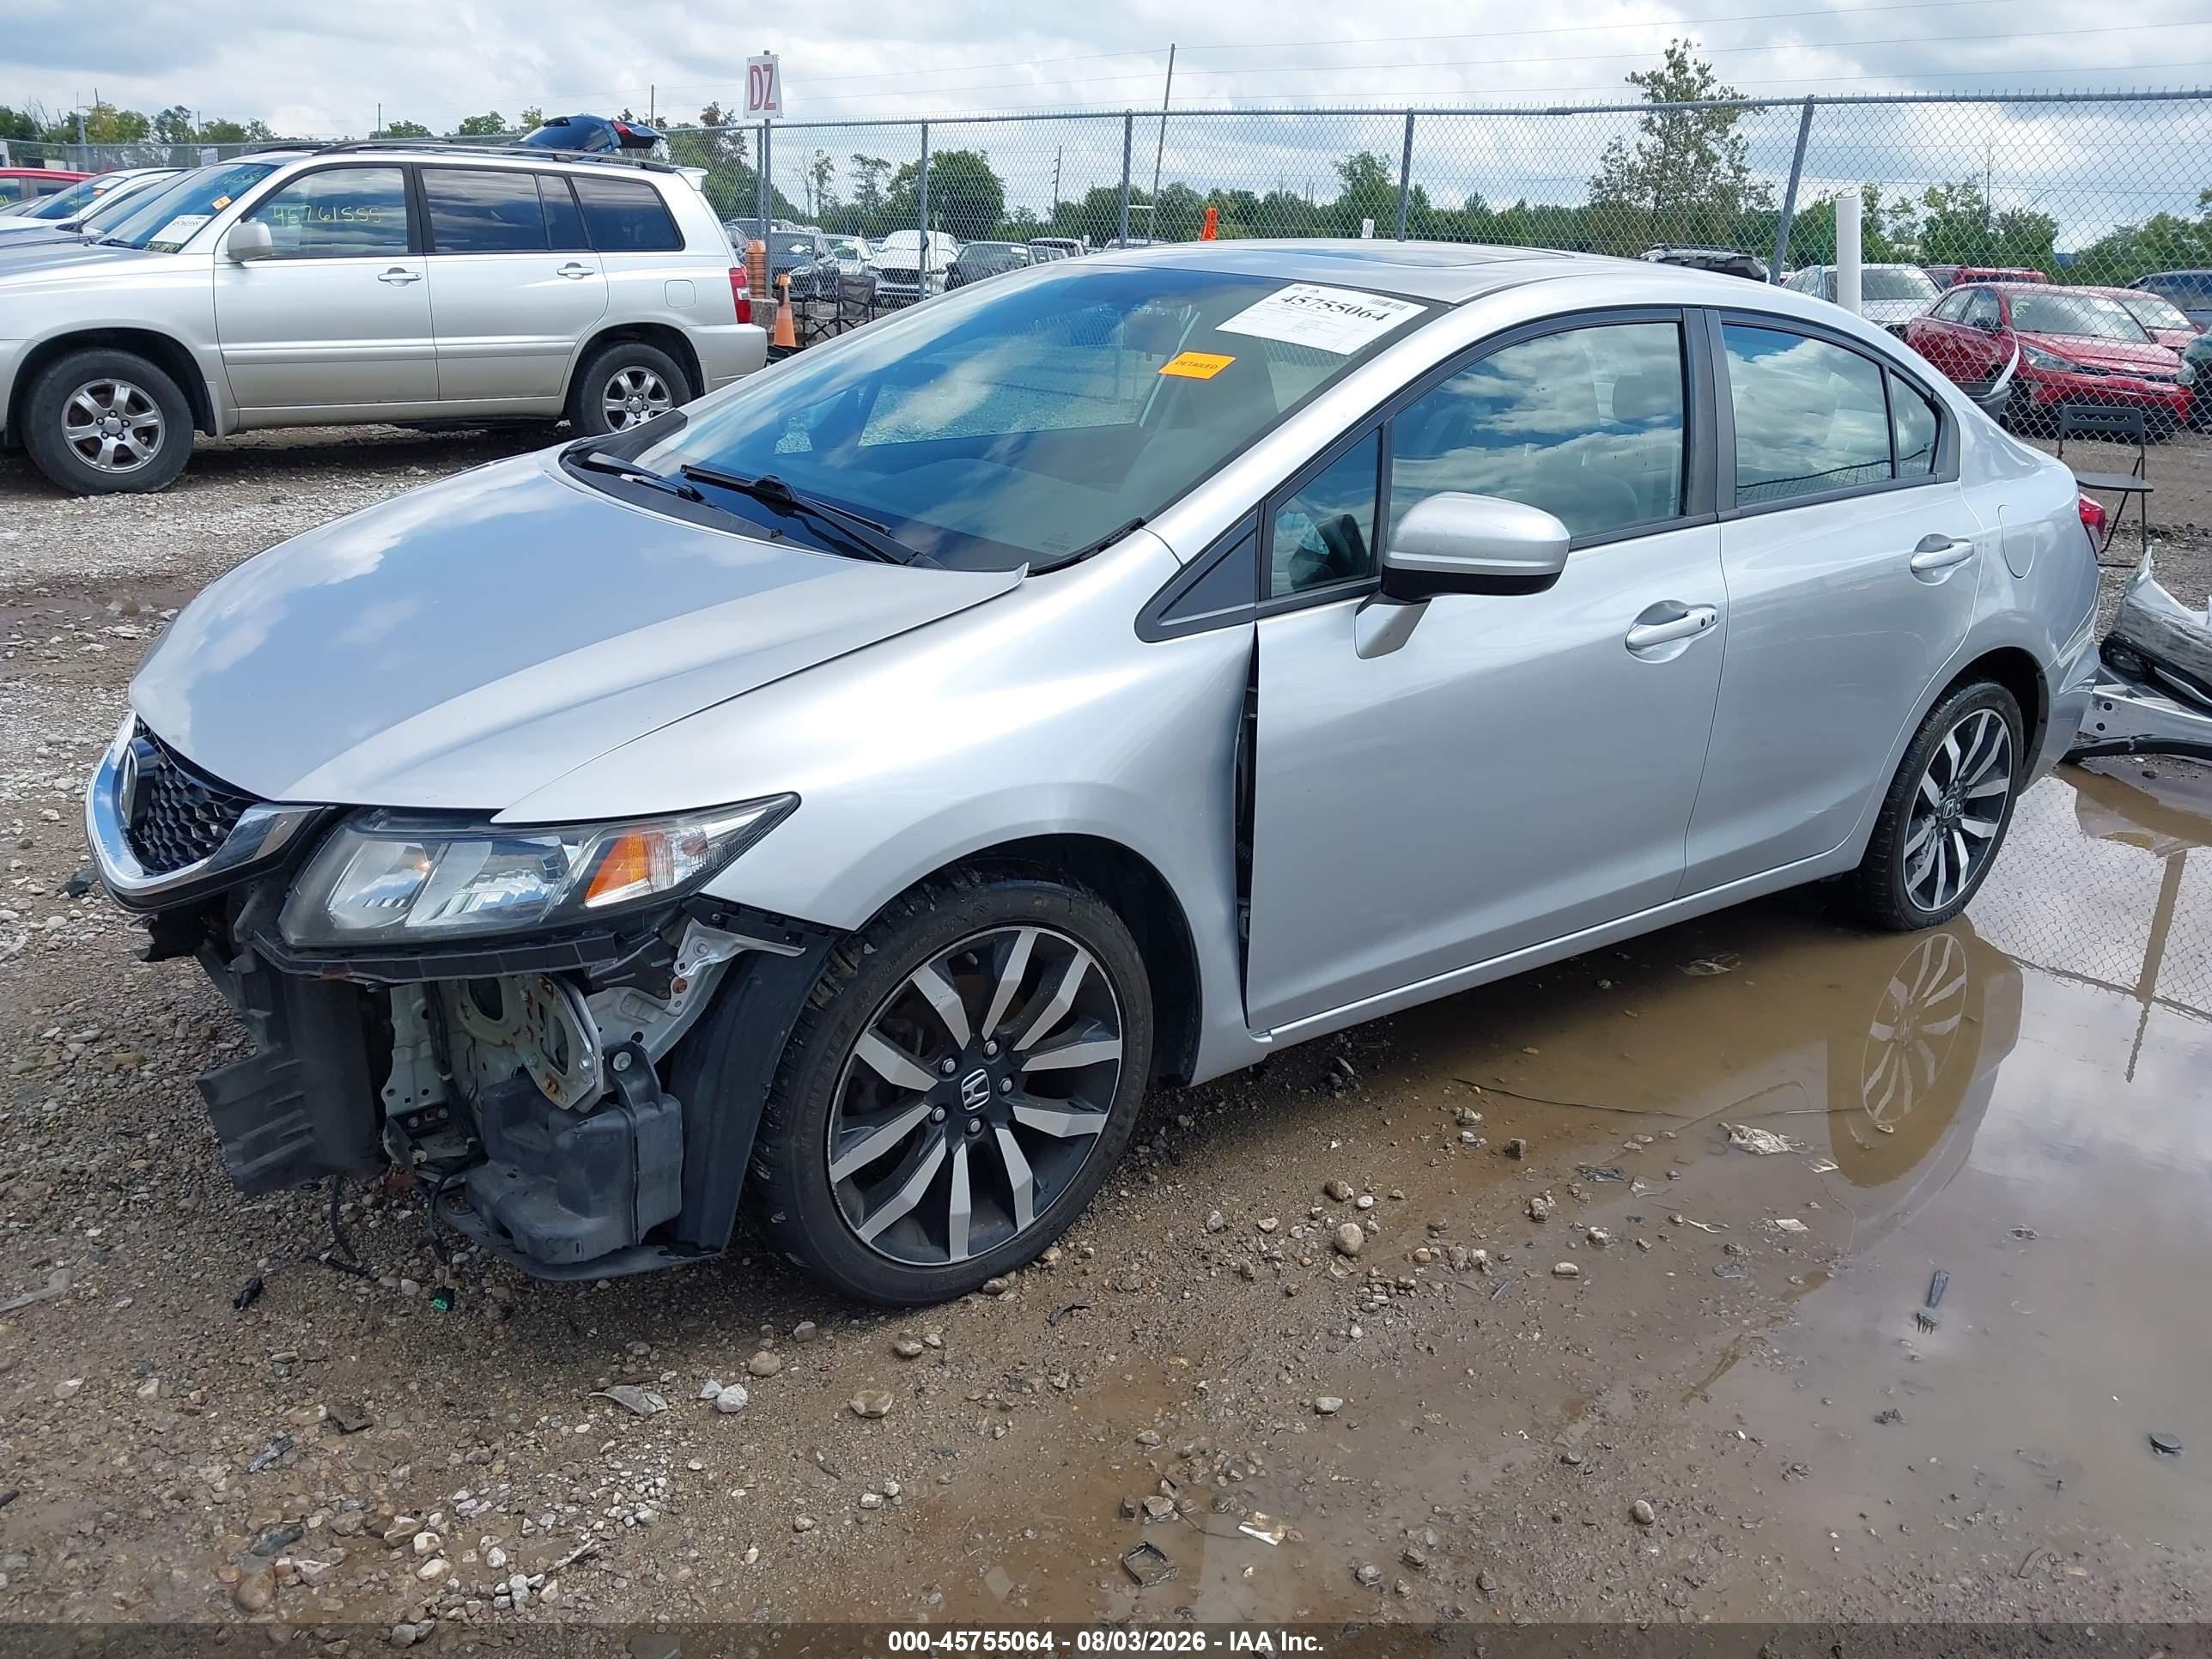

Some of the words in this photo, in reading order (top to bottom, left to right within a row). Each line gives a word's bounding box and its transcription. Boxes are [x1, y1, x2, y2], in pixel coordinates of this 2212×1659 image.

[749, 64, 776, 111] DZ
[274, 204, 381, 227] 45761555
[1281, 295, 1391, 321] 45755064
[1175, 361, 1218, 369] DETAILED
